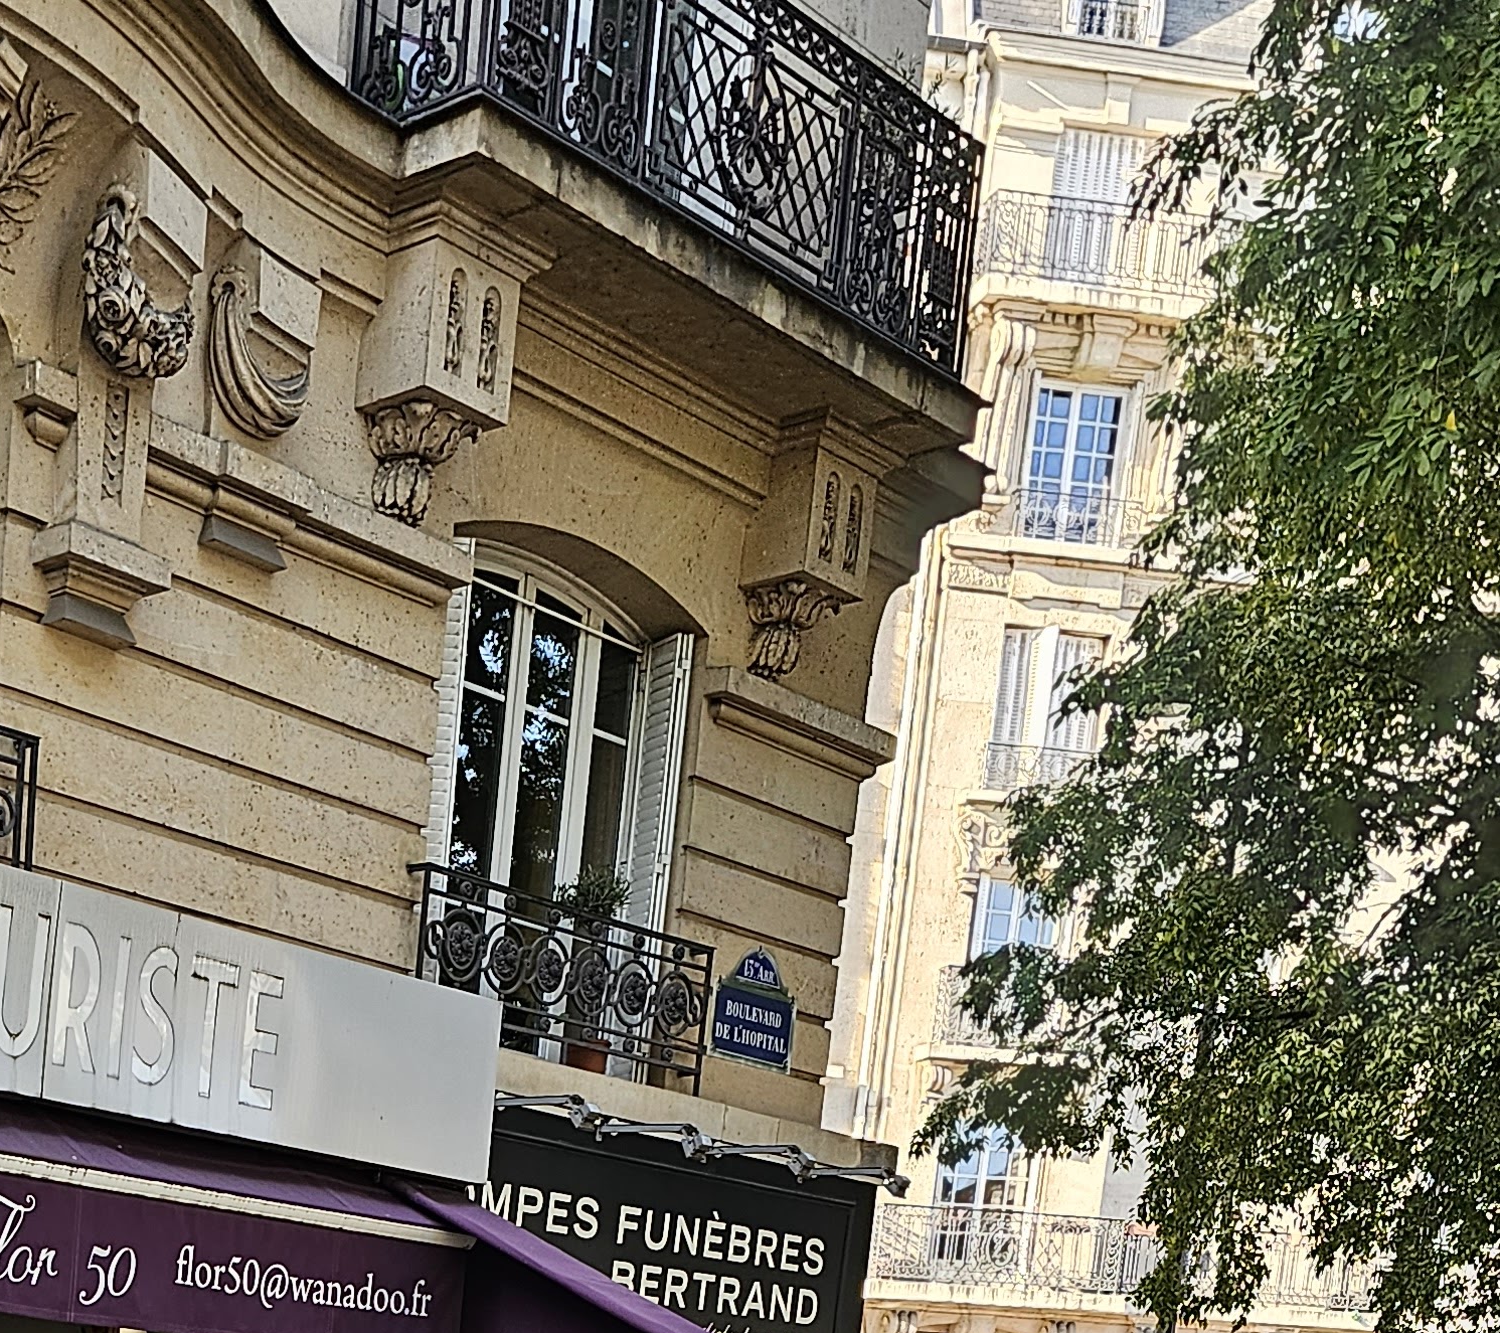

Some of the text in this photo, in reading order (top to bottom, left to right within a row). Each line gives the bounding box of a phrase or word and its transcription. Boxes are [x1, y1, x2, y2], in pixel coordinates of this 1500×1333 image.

[715, 1022, 731, 1040] DE
[725, 1000, 782, 1028] BOULEVARD
[466, 1181, 825, 1276] MPES FUNÈBRES
[79, 1245, 137, 1306] 50
[175, 1244, 433, 1319] flor50@wanadoo.fr
[611, 1259, 819, 1325] BERTRAND
